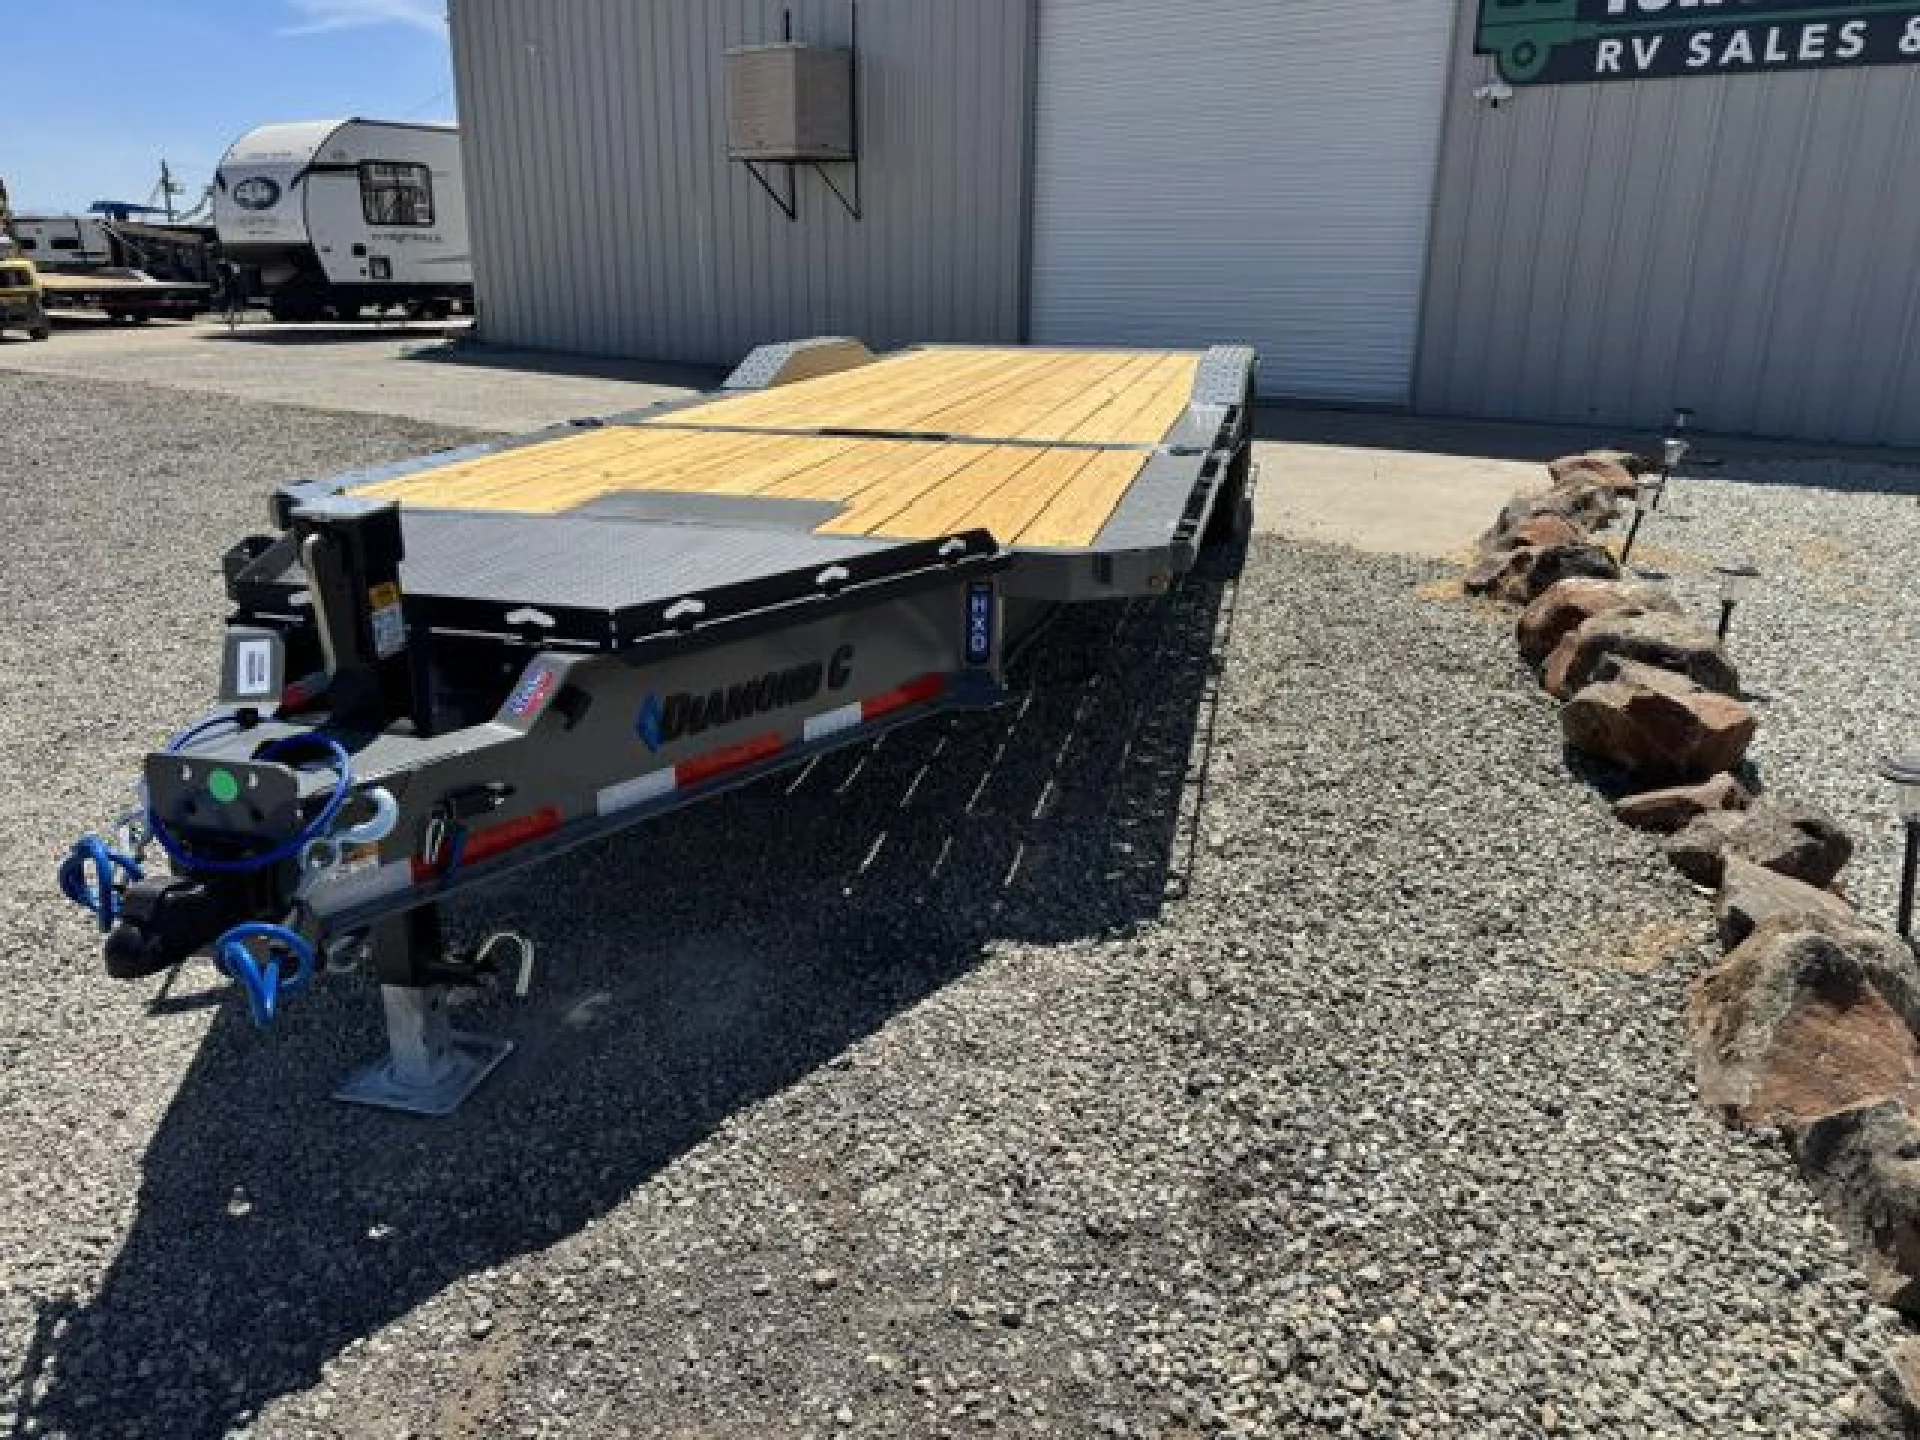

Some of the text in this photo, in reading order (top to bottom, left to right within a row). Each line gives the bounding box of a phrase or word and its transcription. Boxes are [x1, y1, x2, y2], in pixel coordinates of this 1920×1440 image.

[1596, 36, 1662, 72] RV
[1686, 20, 1867, 66] SALES
[827, 644, 854, 691] C
